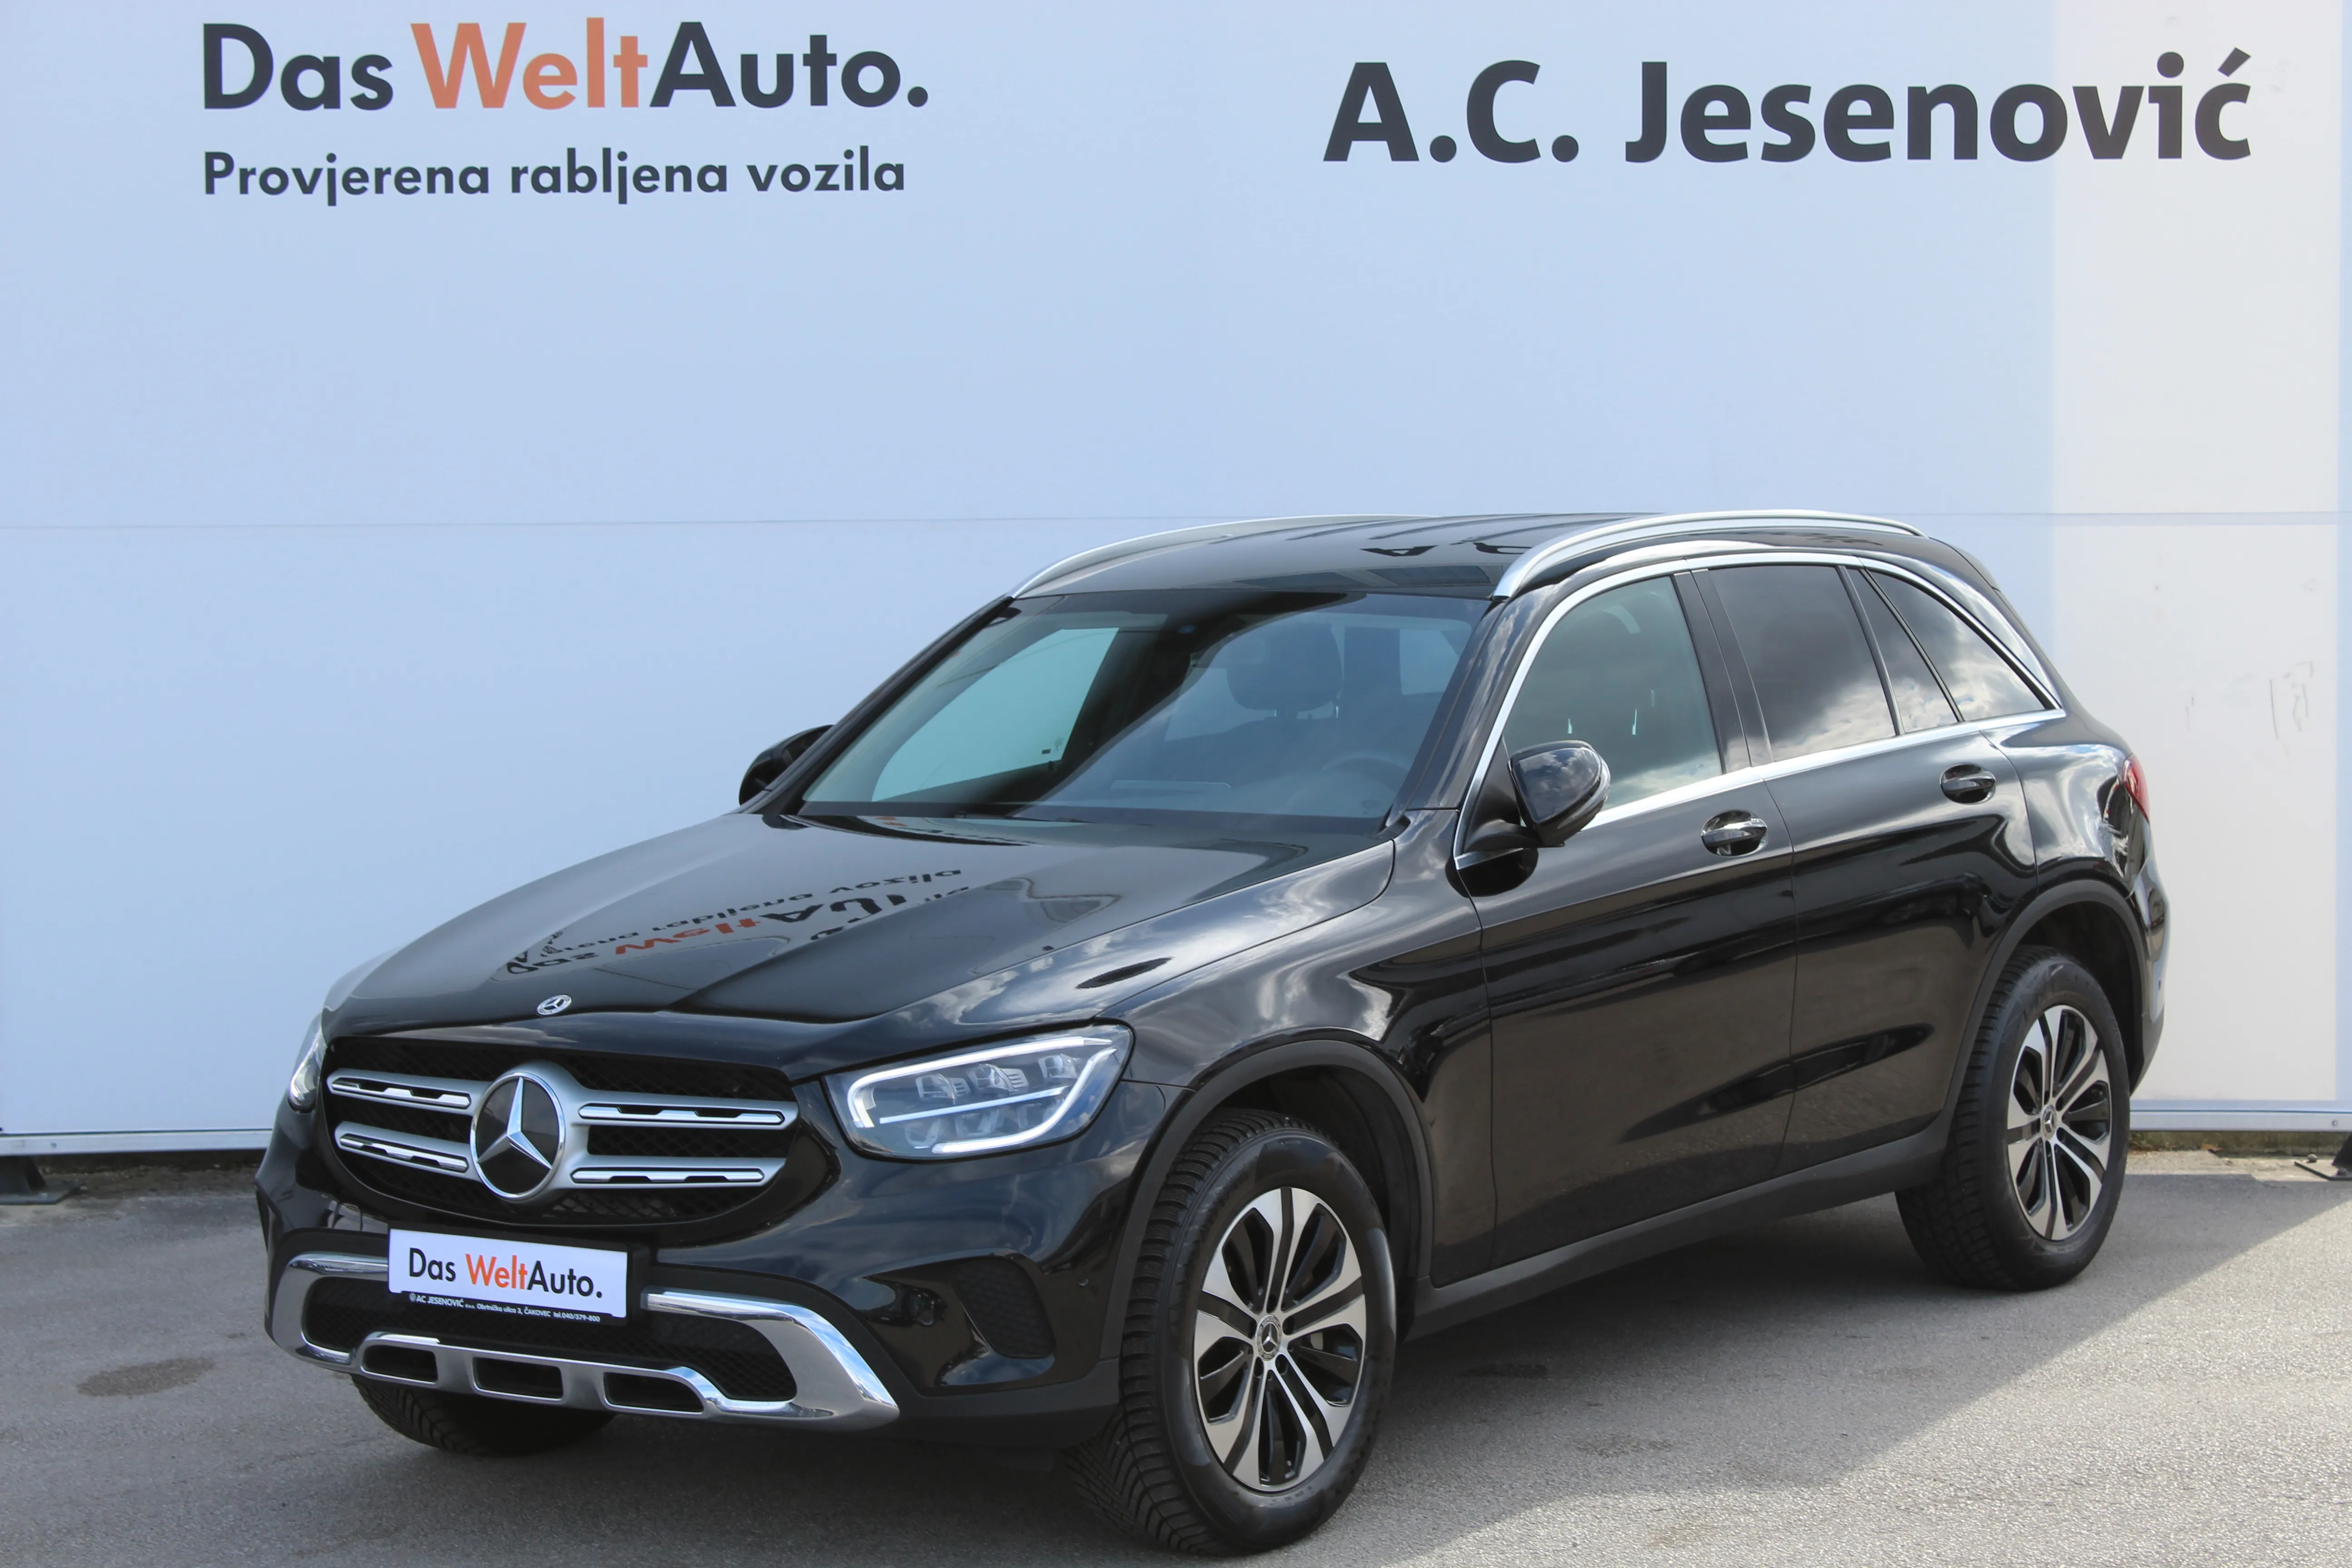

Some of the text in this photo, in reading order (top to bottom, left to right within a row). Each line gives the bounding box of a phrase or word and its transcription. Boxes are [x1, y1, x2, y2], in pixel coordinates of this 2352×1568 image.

[203, 18, 928, 111] Das WeltAuto.
[1323, 47, 2251, 163] A.C. Jesenović
[205, 145, 904, 206] Provjerena rabljena vozila
[410, 1247, 603, 1298] Das WeltAuto.
[416, 1295, 426, 1303] AC
[427, 1297, 464, 1308] JESENOVIĆ
[524, 1307, 551, 1317] ČAKOVEC
